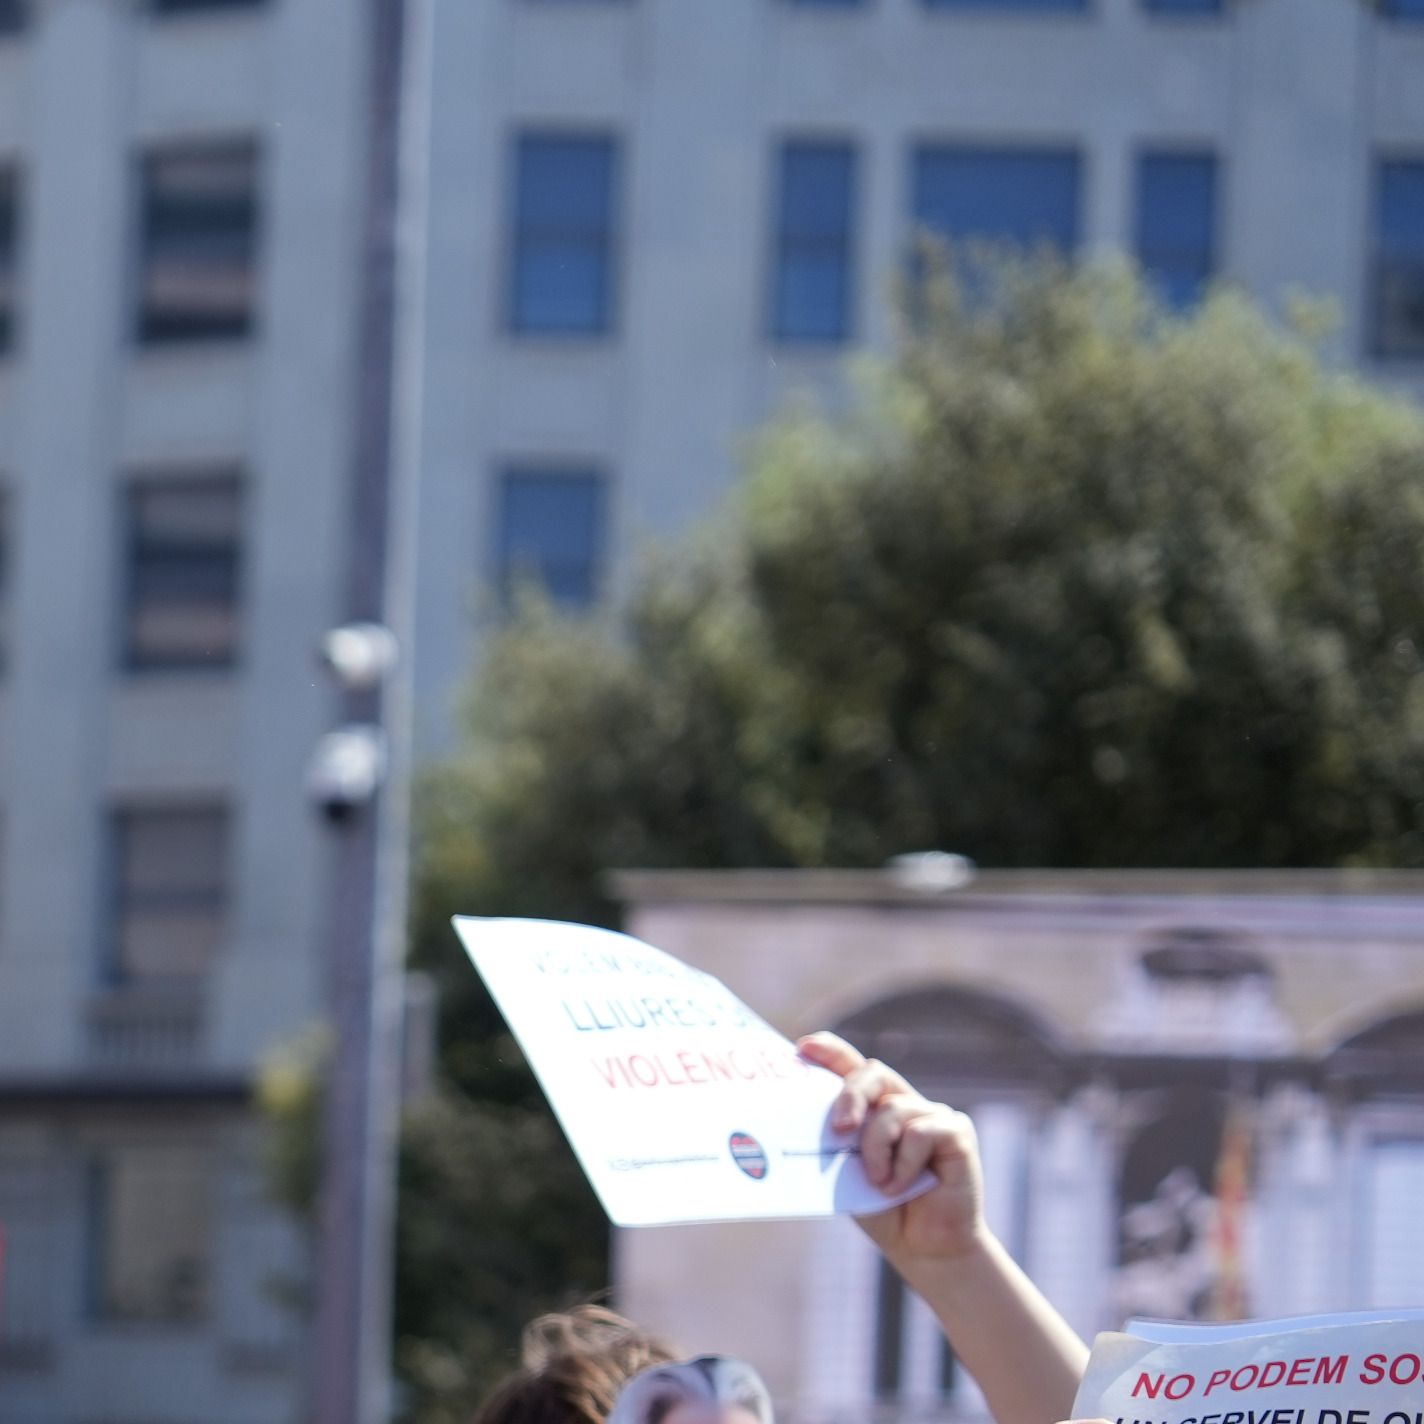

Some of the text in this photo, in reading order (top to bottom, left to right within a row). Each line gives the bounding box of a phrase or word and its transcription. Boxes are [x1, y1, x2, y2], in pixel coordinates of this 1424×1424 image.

[1131, 1353, 1424, 1401] NO PODEM SO
